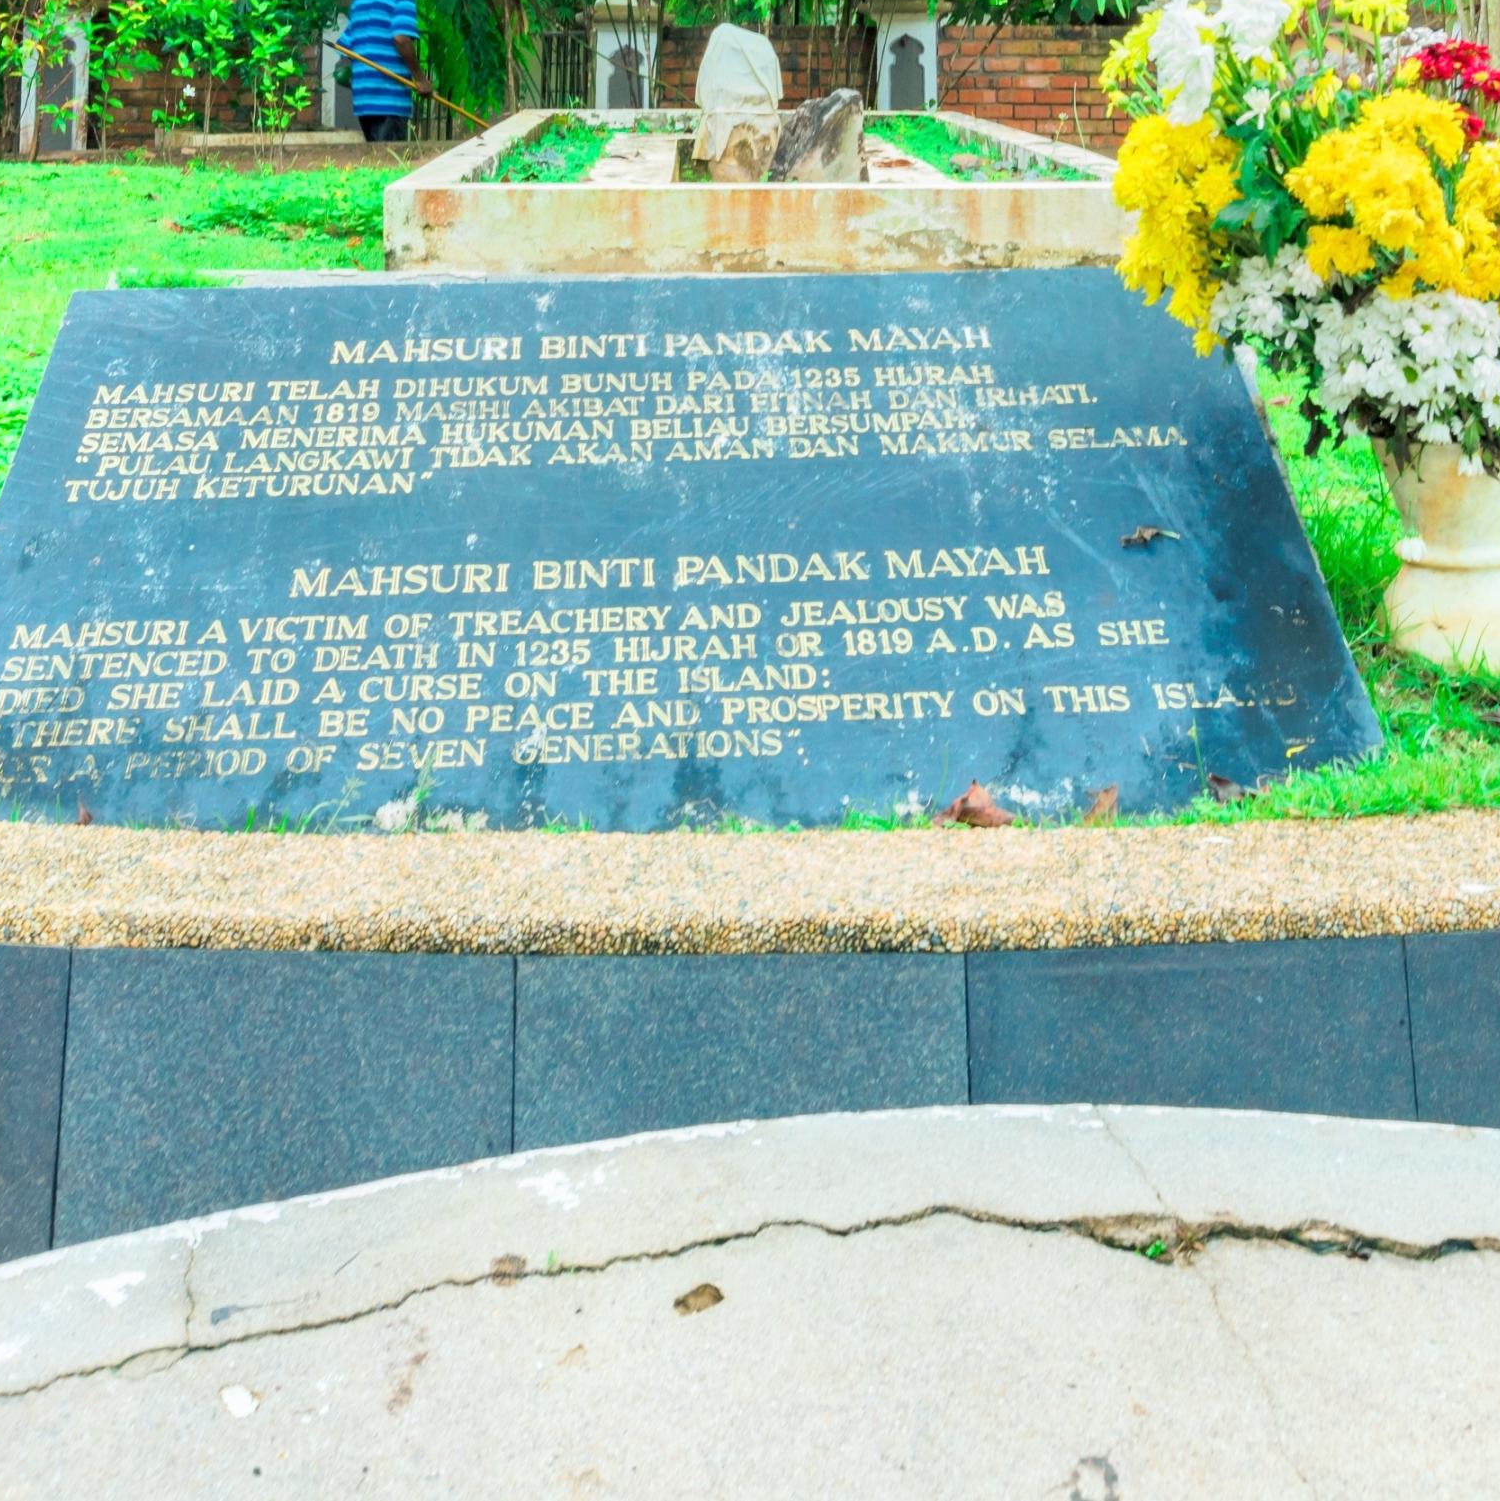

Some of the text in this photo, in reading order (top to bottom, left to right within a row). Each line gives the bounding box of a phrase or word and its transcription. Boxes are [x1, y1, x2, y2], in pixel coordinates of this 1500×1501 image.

[330, 325, 992, 365] MAHSURI BINTI PANDAK MAYAH
[84, 383, 1098, 429] BERSAMAAN 1819 MASIHI AKIBAT DARI FITNAH DAN IRIHATI.
[92, 364, 995, 405] MAHSURI TELAH DIHUKUM BUNUH PADA 1235 HIJRAH
[78, 430, 220, 454] SEMASA
[240, 425, 427, 450] MENERIMA
[440, 419, 614, 445] HUKUMAN
[631, 415, 749, 440] BELIAU
[222, 447, 414, 473] LANGKAWI
[430, 443, 532, 469] TIDAK
[547, 441, 653, 466] AKAN
[665, 437, 775, 462] AMAN
[788, 434, 860, 458] DAN
[879, 430, 1034, 456] MAKMUR
[1048, 426, 1188, 449] SELAMA
[64, 479, 180, 502] TUJUH
[289, 546, 1050, 598] MAHSURI BINTI PANDAK MAYAH
[8, 590, 1066, 649] MAHSURI A VICTIM OF TREACHERY AND JEALOUSY WAS
[0, 619, 1169, 682] SENTENCED TO DEATH IN 1235 HIJRAH OR 1819 A.D. AS SHE
[106, 682, 183, 710] SHE
[200, 677, 300, 708] LAID
[311, 677, 346, 704] A
[358, 672, 482, 703] CURSE
[504, 670, 557, 698] ON
[582, 667, 658, 697] THE
[677, 663, 831, 694] ISLAND:
[161, 712, 297, 743] SHALL
[318, 708, 370, 737] BE
[389, 706, 445, 734] NO
[465, 701, 594, 733] PEACE
[611, 700, 701, 730] AND
[720, 690, 954, 725] PROSPERITY
[972, 688, 1027, 717] ON
[1042, 685, 1131, 713] THIS
[1152, 682, 1298, 710] ISLAD
[68, 754, 100, 783] A
[123, 747, 267, 780] PERIOD
[285, 744, 337, 773] OF
[356, 738, 487, 772] SEVEN
